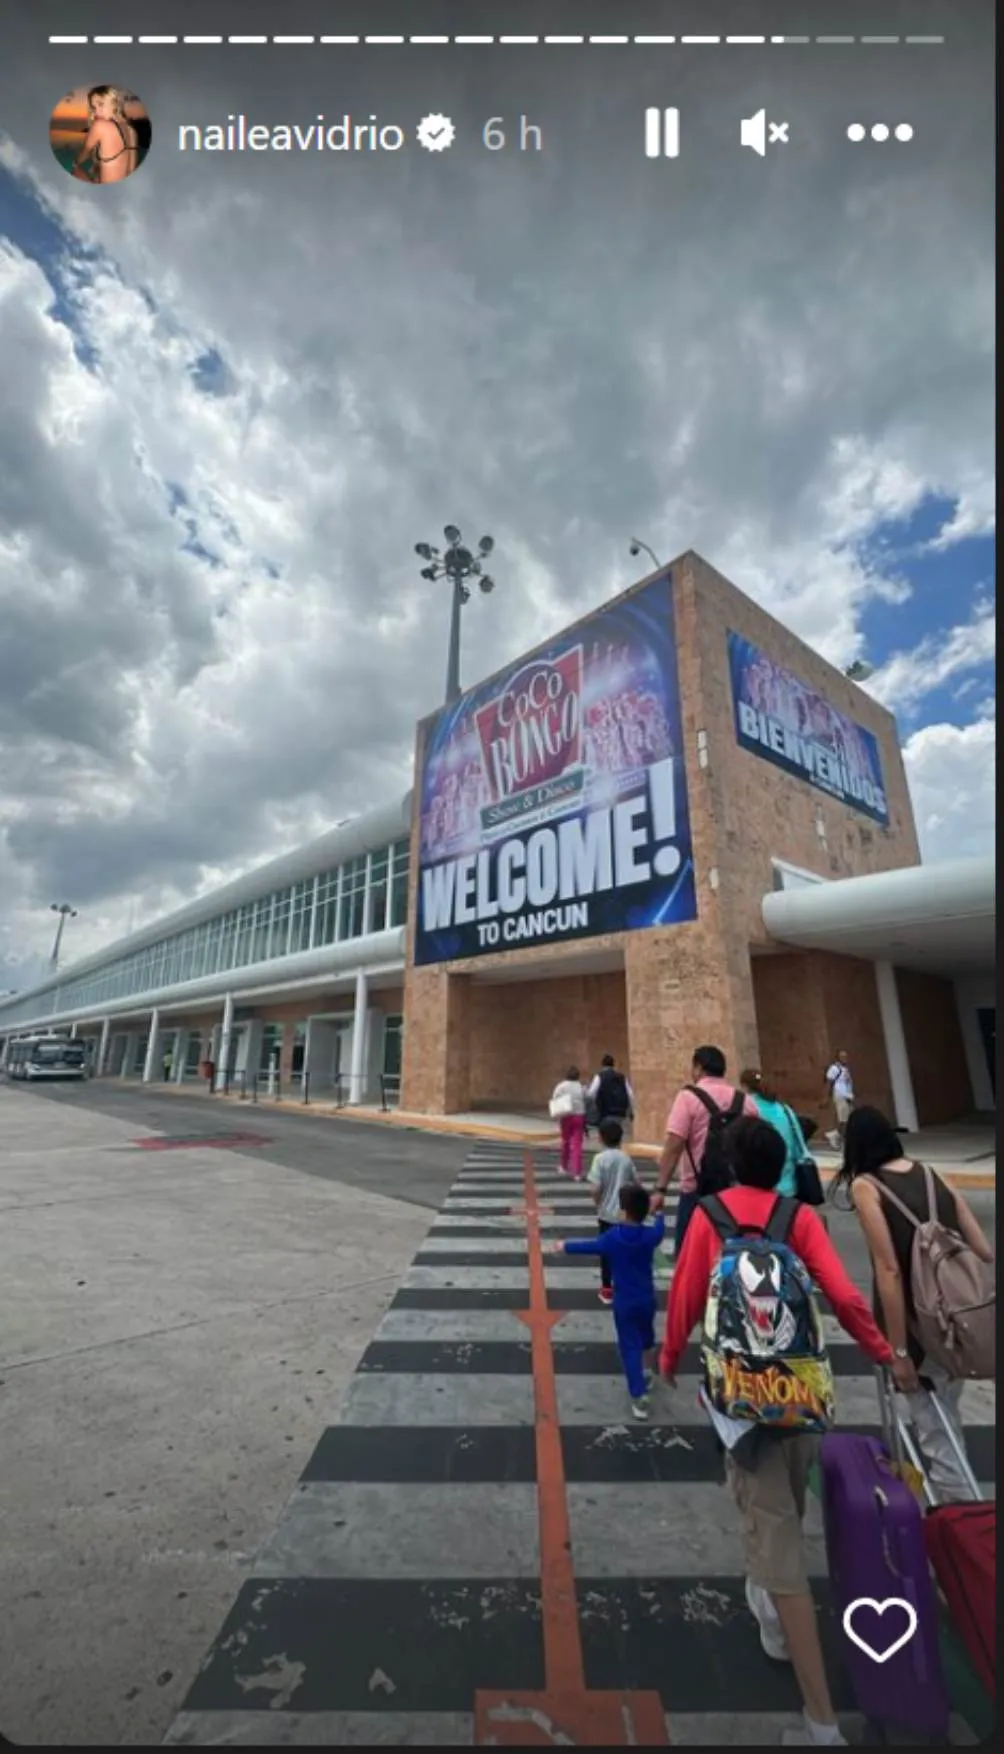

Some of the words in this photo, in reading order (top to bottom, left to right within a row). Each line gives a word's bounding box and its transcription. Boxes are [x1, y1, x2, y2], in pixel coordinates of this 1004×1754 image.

[490, 690, 578, 800] BONGO
[737, 701, 887, 814] BIENVENIDOS
[422, 757, 682, 932] WELCOME!
[477, 919, 500, 947] TO
[503, 901, 589, 941] CANCUN
[720, 1358, 822, 1416] VENOM
